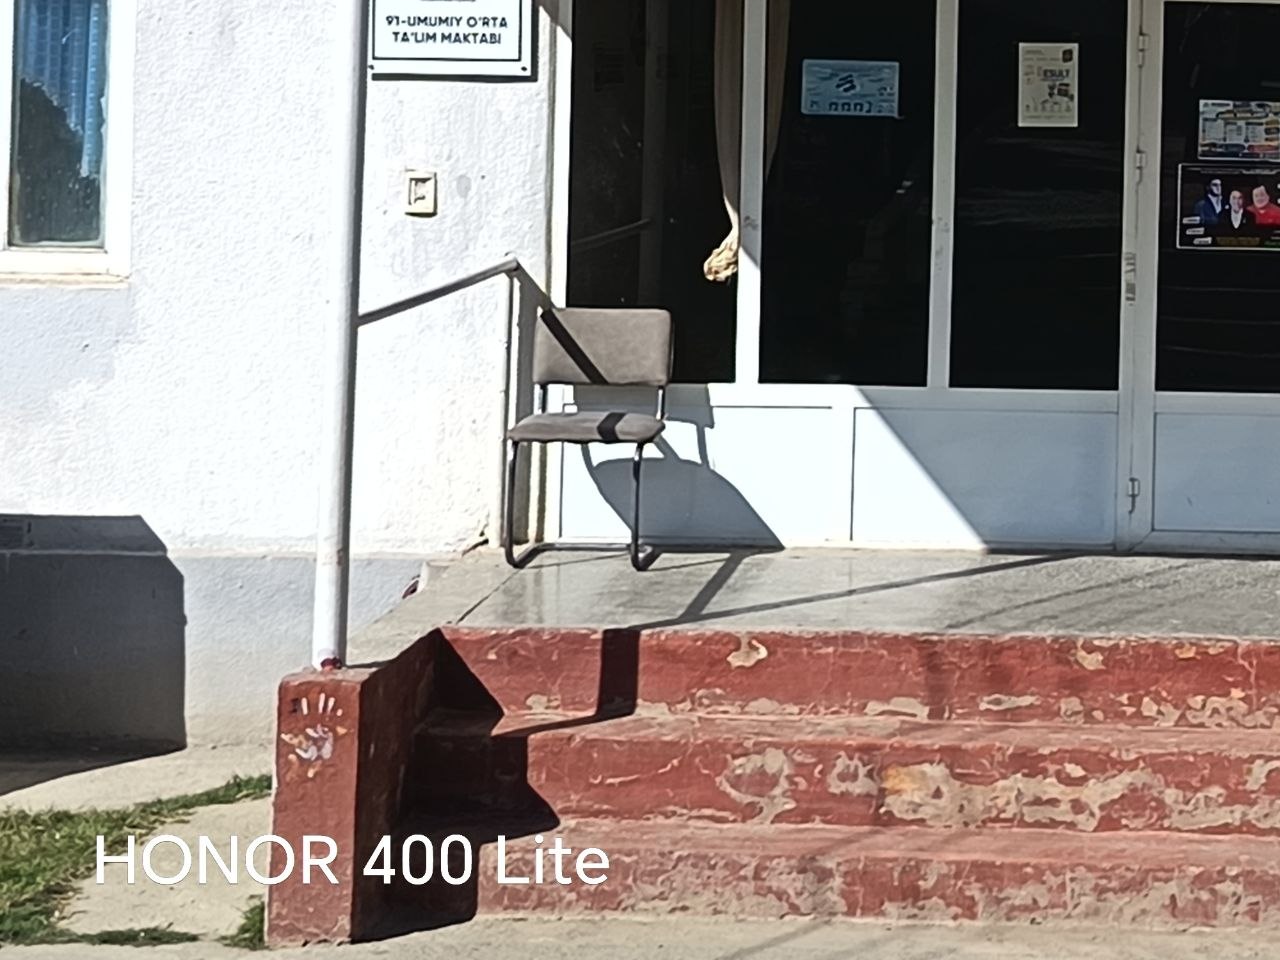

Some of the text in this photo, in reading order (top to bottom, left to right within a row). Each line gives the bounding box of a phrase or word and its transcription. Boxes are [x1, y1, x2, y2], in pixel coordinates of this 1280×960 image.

[385, 15, 508, 28] 91-UMUMIY O'RTA
[392, 31, 501, 44] TA'LIM MAKTABI
